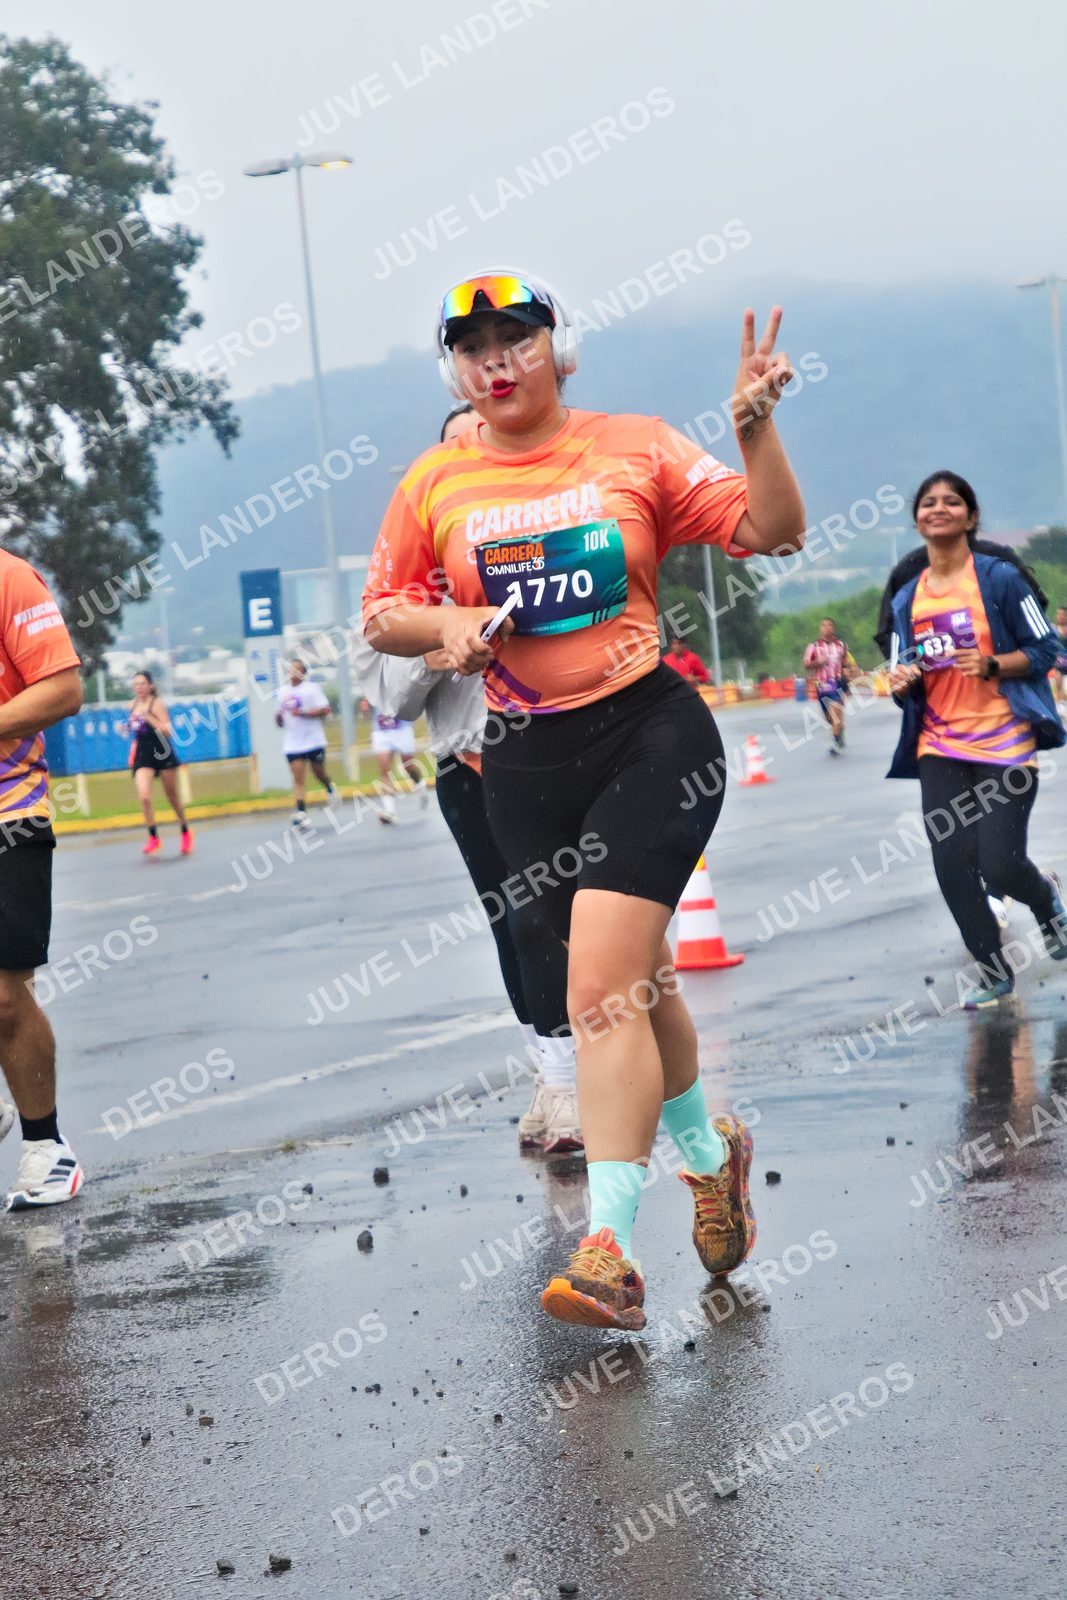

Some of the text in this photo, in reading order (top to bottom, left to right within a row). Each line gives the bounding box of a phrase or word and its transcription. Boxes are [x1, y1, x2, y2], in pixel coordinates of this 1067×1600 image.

[466, 483, 601, 542] CARRERA
[484, 542, 545, 565] CARRERA
[583, 528, 610, 552] 10K
[486, 561, 532, 576] OMNILIFE
[506, 569, 593, 608] 1770
[249, 597, 274, 630] E
